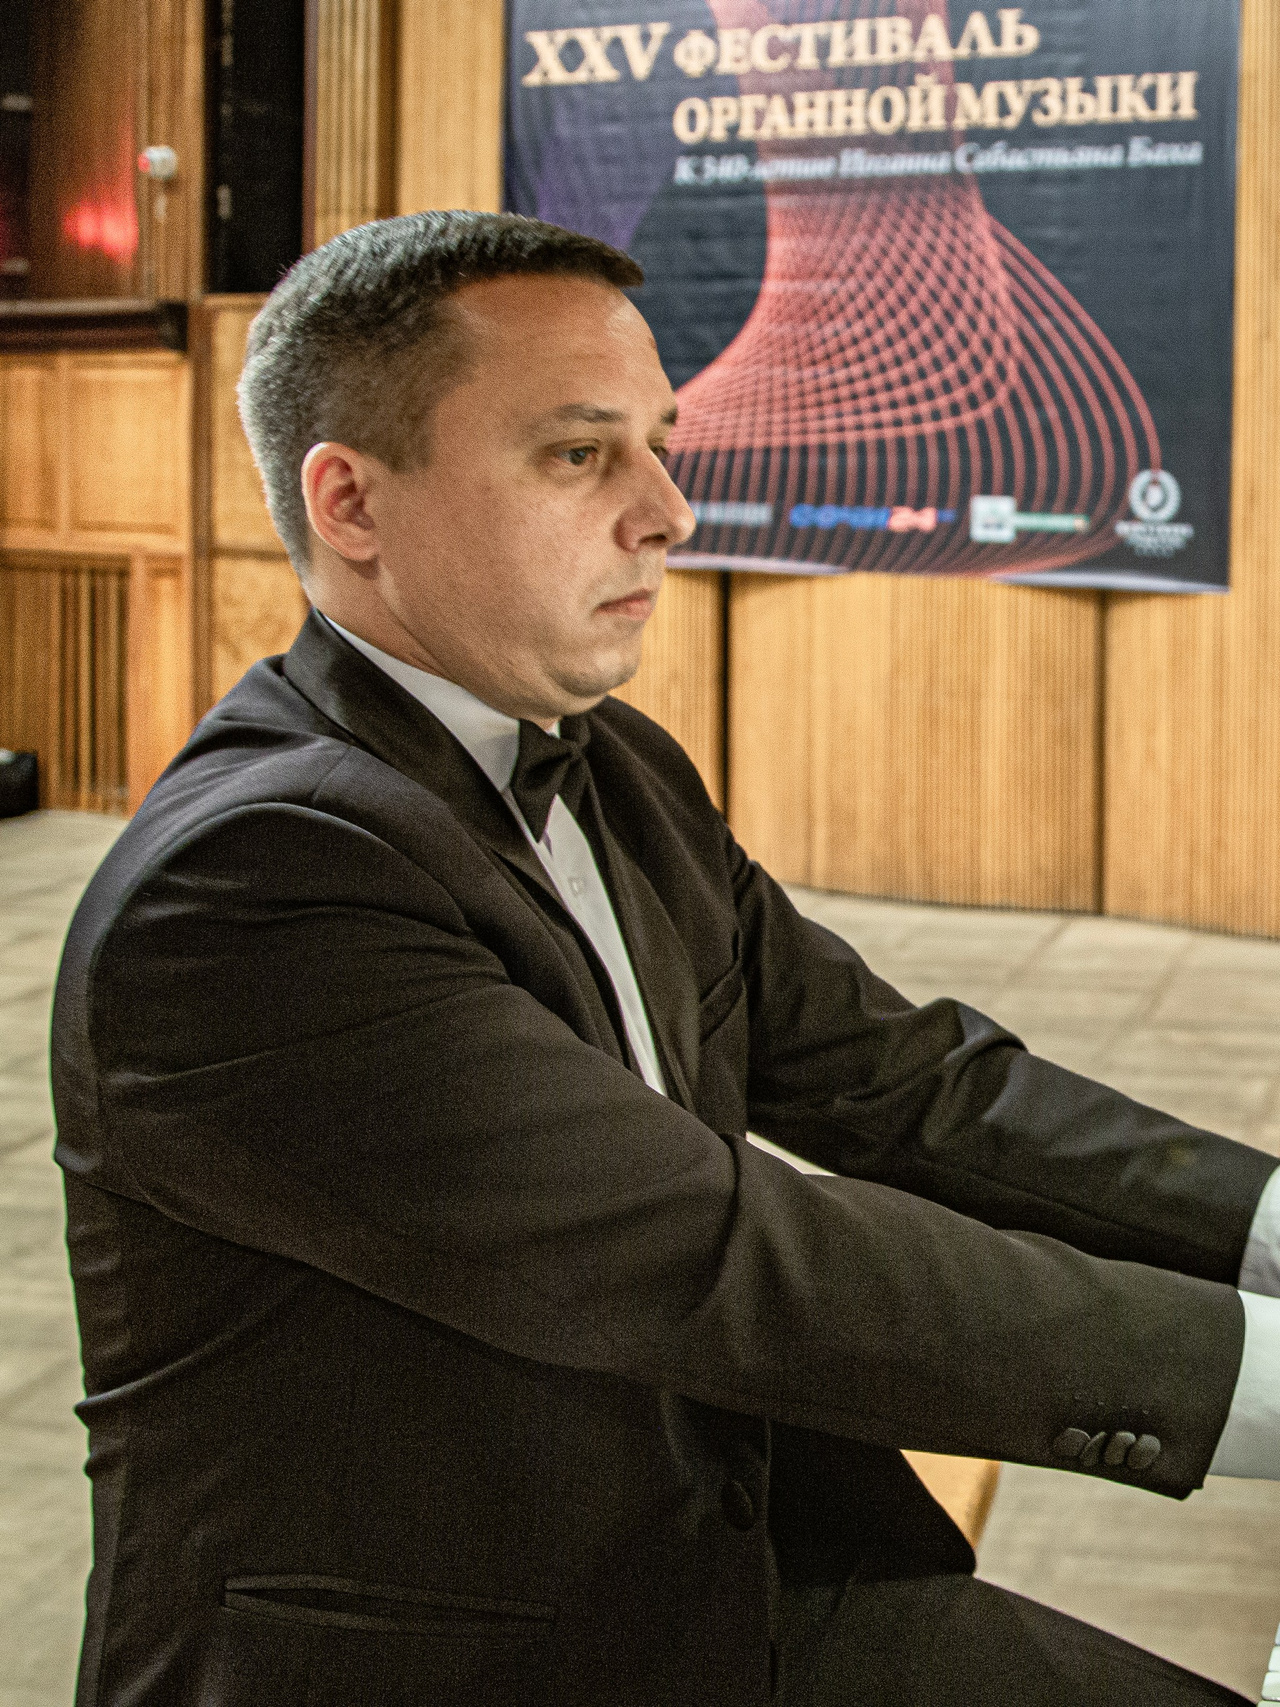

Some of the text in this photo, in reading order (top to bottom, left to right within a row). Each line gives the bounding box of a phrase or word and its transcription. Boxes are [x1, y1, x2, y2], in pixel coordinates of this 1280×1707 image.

[522, 7, 1041, 87] XXV ФЕСТИВАЛЬ
[673, 70, 1200, 144] ОРГАННОЙ МУЗЫКИ
